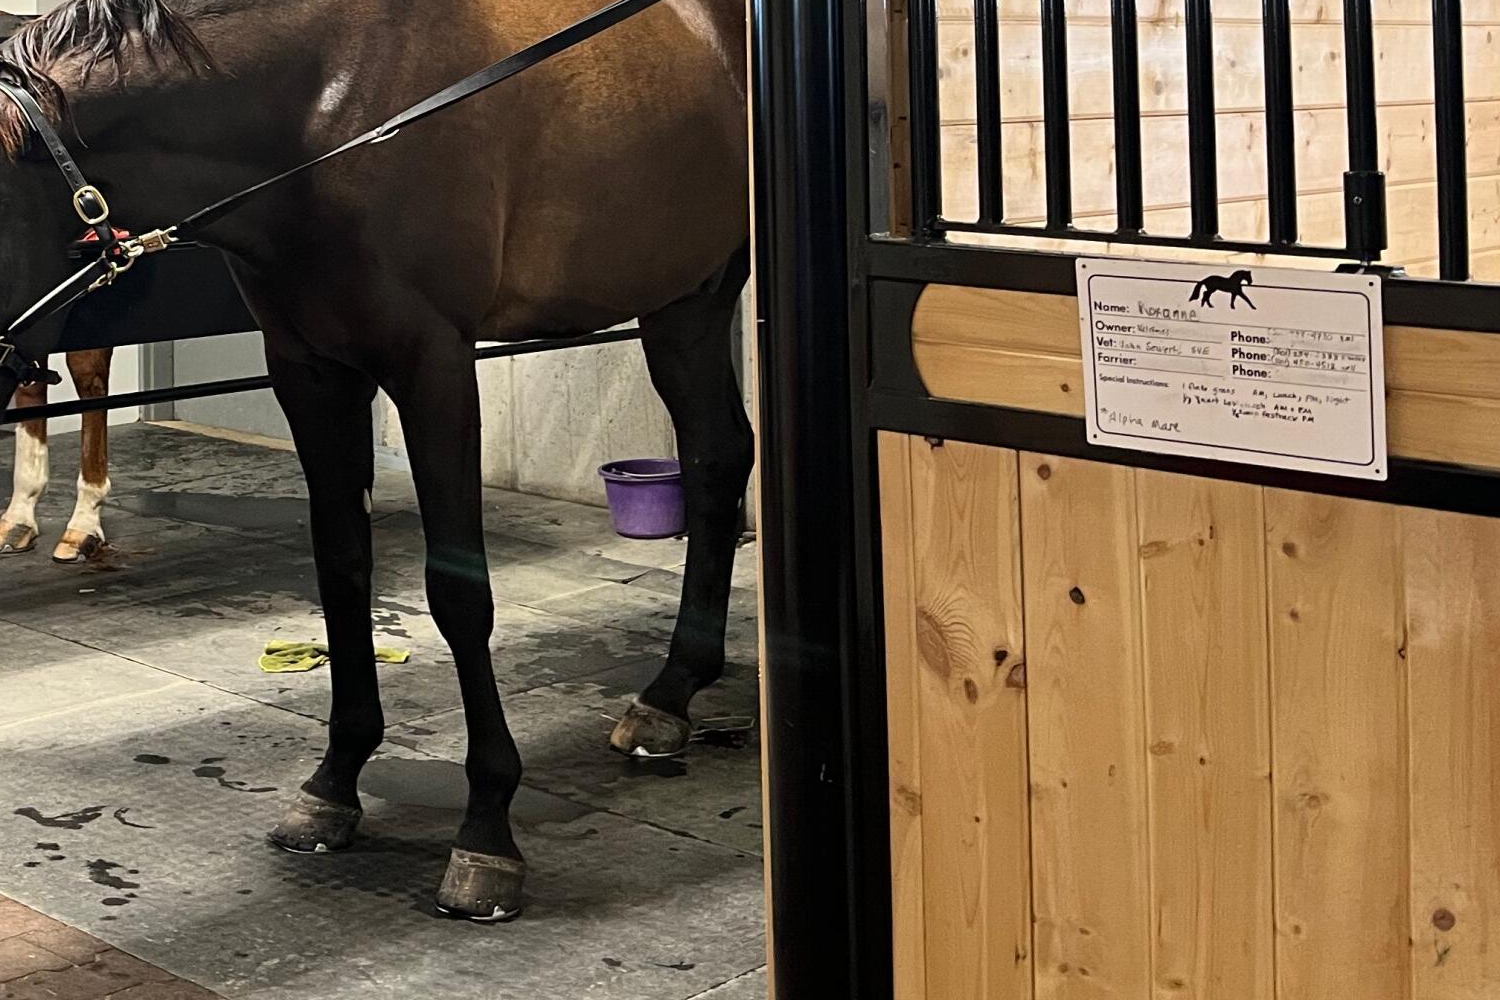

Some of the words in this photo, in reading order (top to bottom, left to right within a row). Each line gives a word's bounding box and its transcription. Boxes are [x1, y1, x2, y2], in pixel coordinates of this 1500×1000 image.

[1094, 301, 1129, 313] Name:
[1095, 320, 1135, 333] Owner:
[1096, 336, 1117, 347] Vet:
[1231, 330, 1270, 344] Phone:
[1097, 352, 1137, 365] Farrier:
[1231, 347, 1270, 361] Phone:
[1232, 364, 1272, 378] Phone:
[1099, 373, 1125, 384] Special
